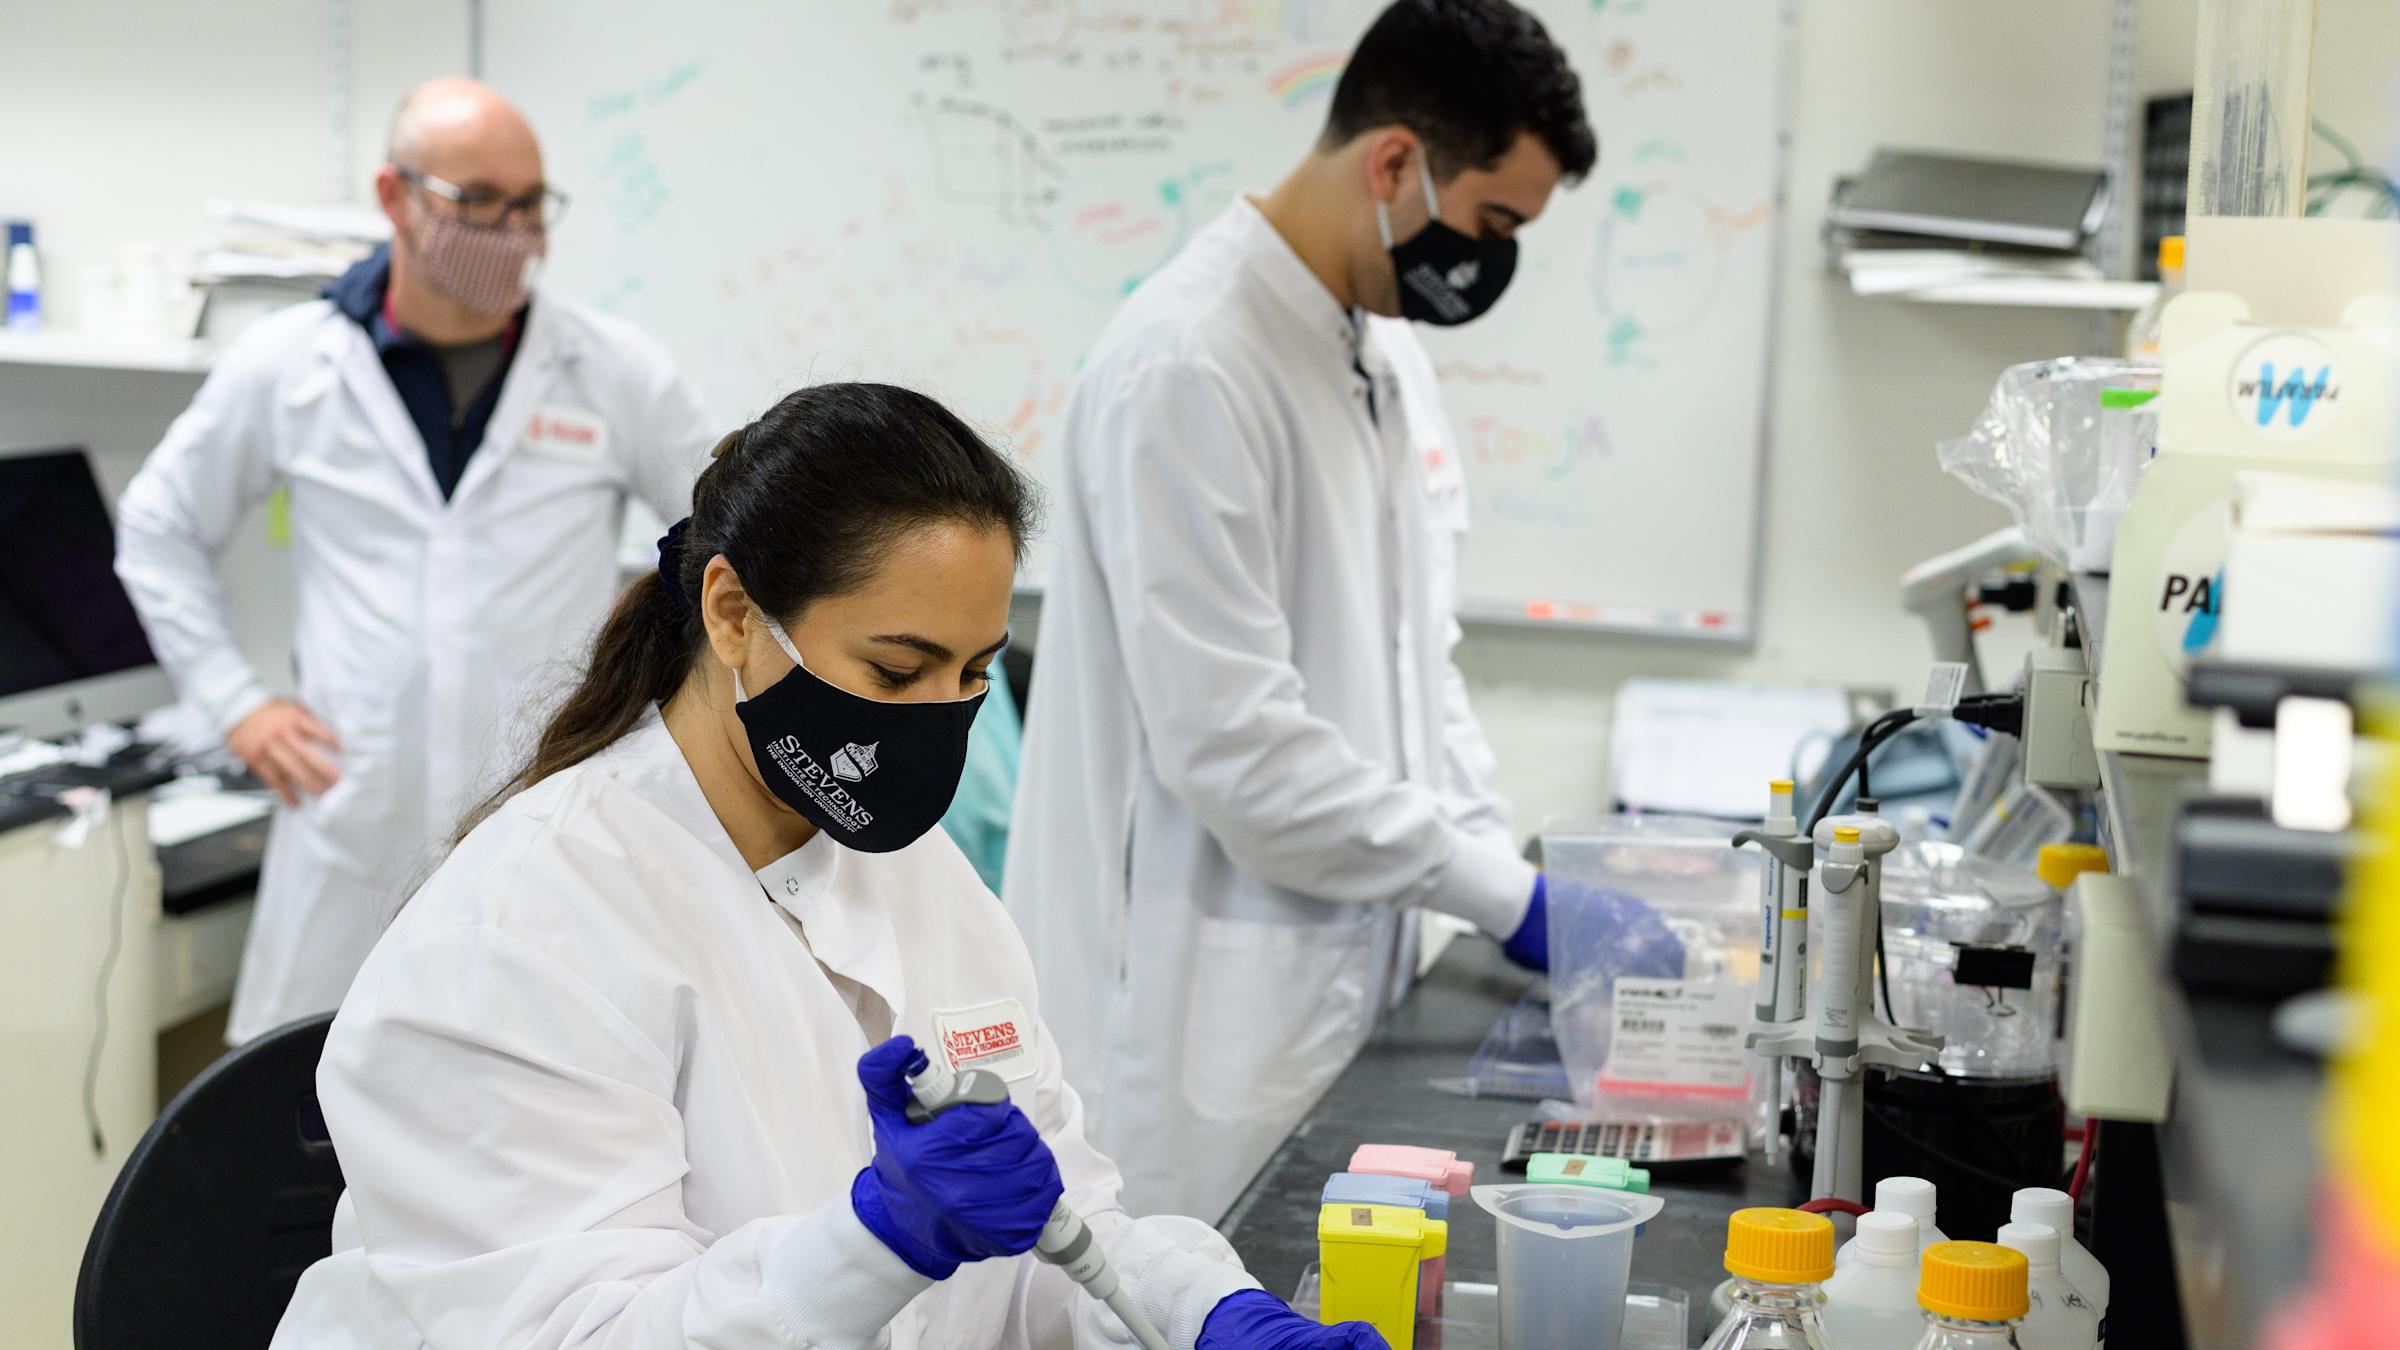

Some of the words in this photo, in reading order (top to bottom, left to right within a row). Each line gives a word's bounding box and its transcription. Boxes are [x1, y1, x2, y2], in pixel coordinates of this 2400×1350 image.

[2161, 574, 2222, 615] PA
[766, 744, 779, 760] THE
[777, 760, 814, 798] INNOVATION
[772, 741, 807, 779] INSTITUTE
[815, 787, 863, 829] TECHNOLOGY
[779, 735, 874, 825] STEVENS
[952, 1021, 1016, 1048] STEVENS
